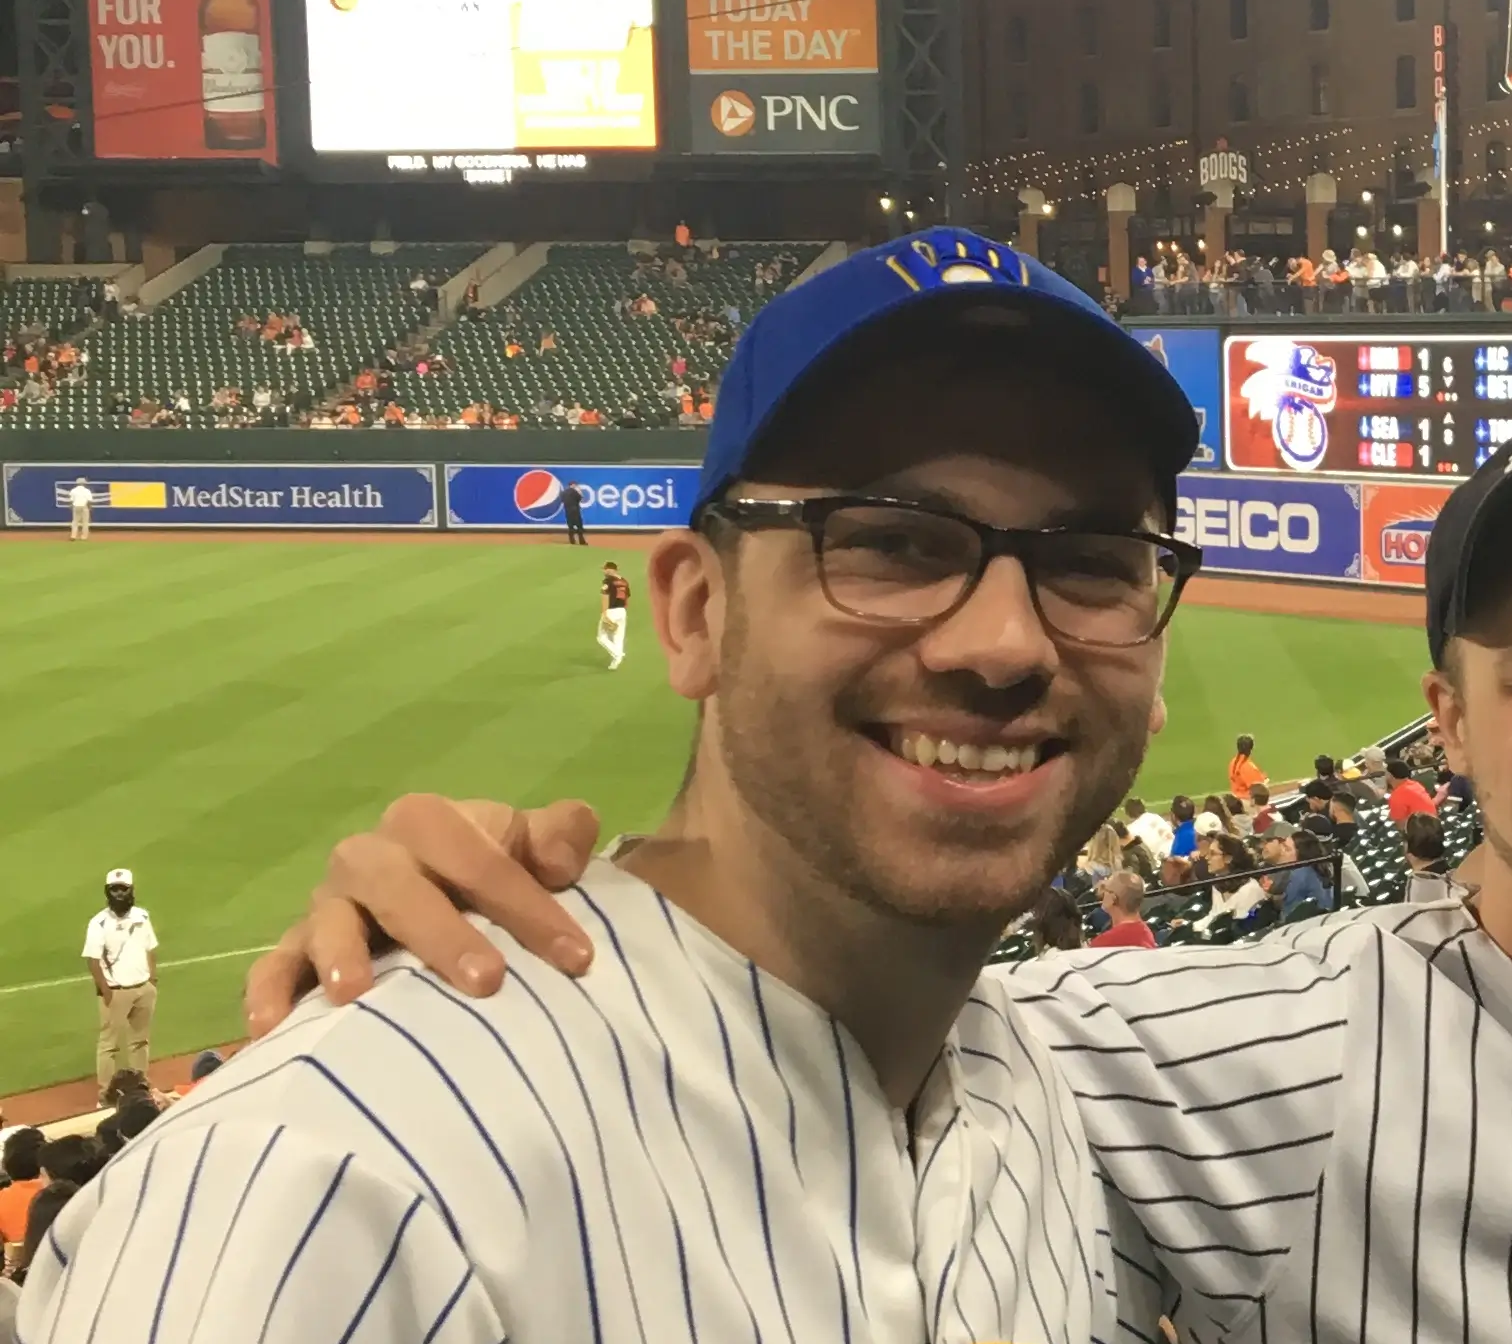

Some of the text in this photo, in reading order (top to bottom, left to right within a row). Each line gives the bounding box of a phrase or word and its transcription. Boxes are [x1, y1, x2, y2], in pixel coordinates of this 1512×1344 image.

[97, 33, 176, 70] YOU.
[703, 30, 773, 61] THE
[761, 95, 860, 132] PNC
[1418, 347, 1430, 372] 1
[1418, 375, 1430, 398] 5
[1418, 418, 1430, 441] 1
[1418, 444, 1430, 468] 1
[171, 483, 384, 508] MedStar Health
[1174, 496, 1320, 554] GEICO
[1384, 532, 1428, 561] HO
